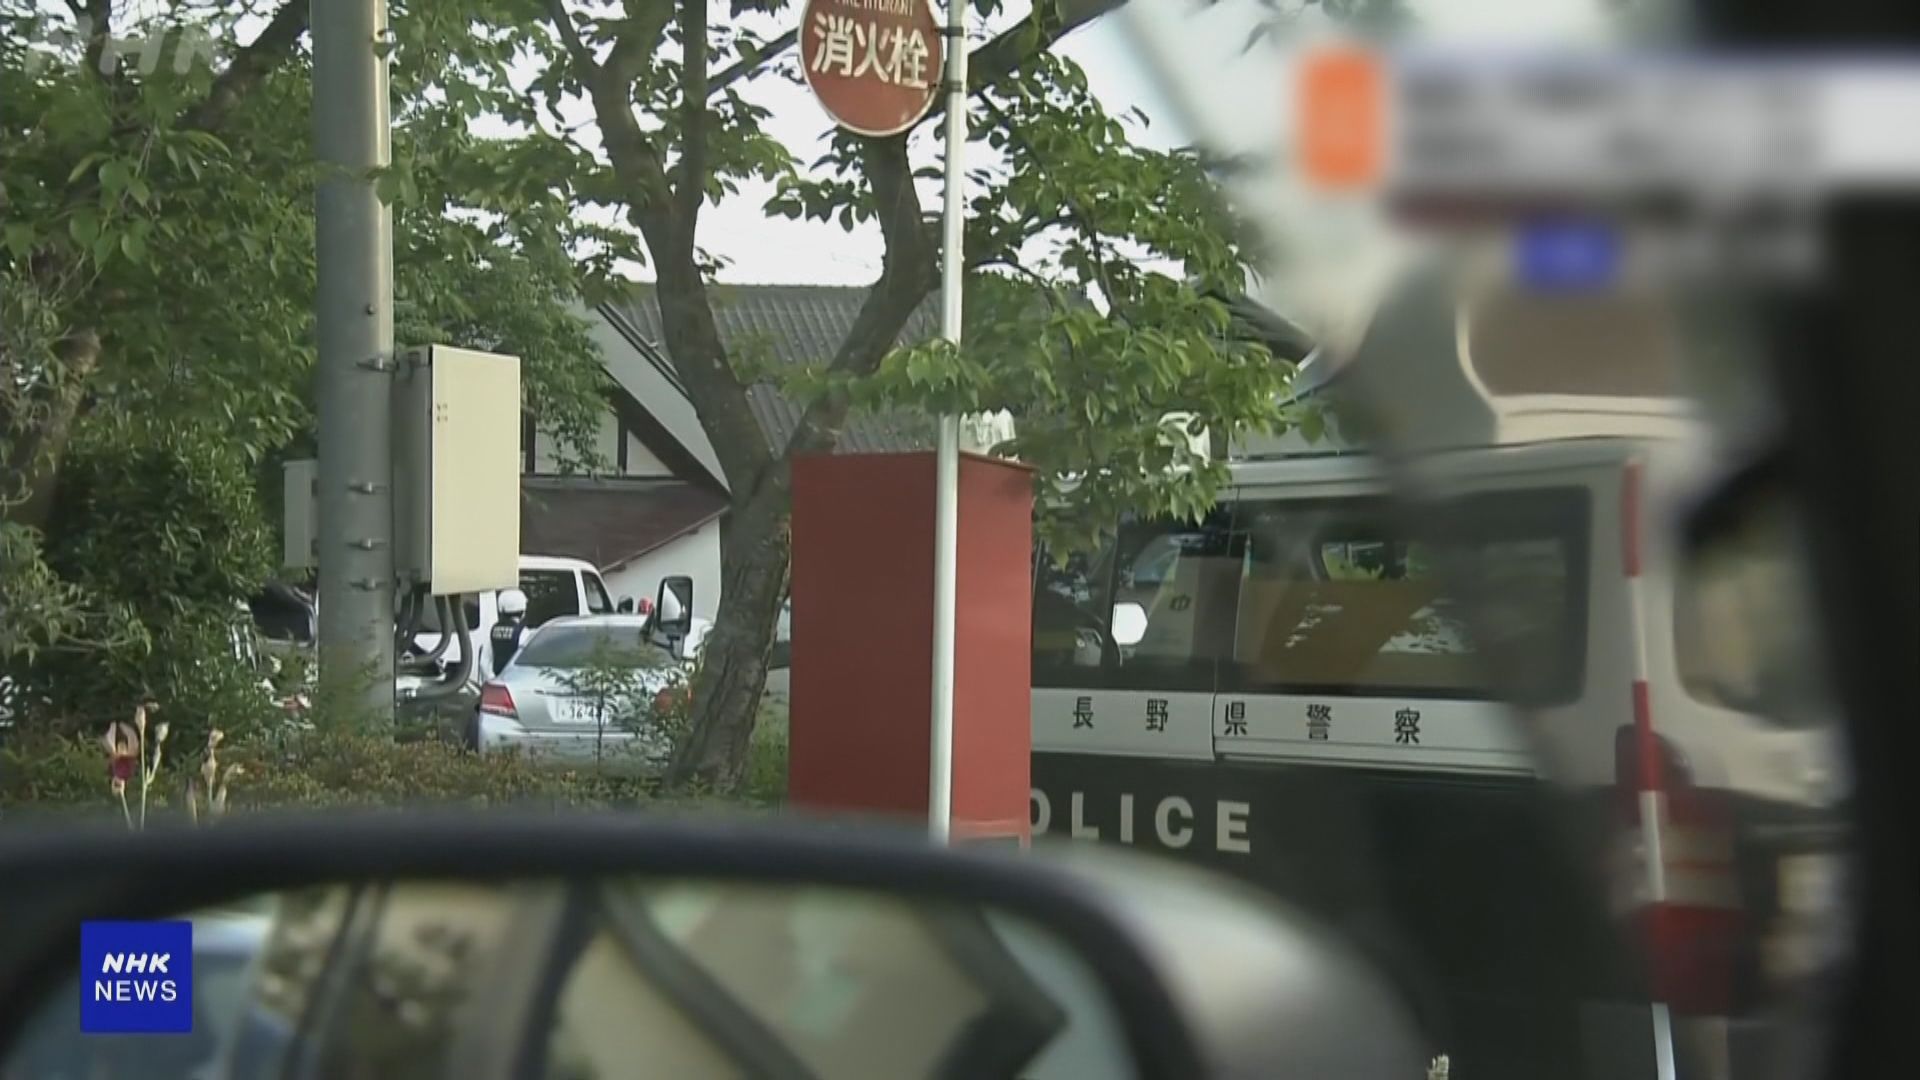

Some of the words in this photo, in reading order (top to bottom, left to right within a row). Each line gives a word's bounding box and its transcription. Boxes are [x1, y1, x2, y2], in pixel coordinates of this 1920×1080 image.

[811, 12, 928, 89] 消火栓
[1073, 696, 1421, 745] 長野県警察
